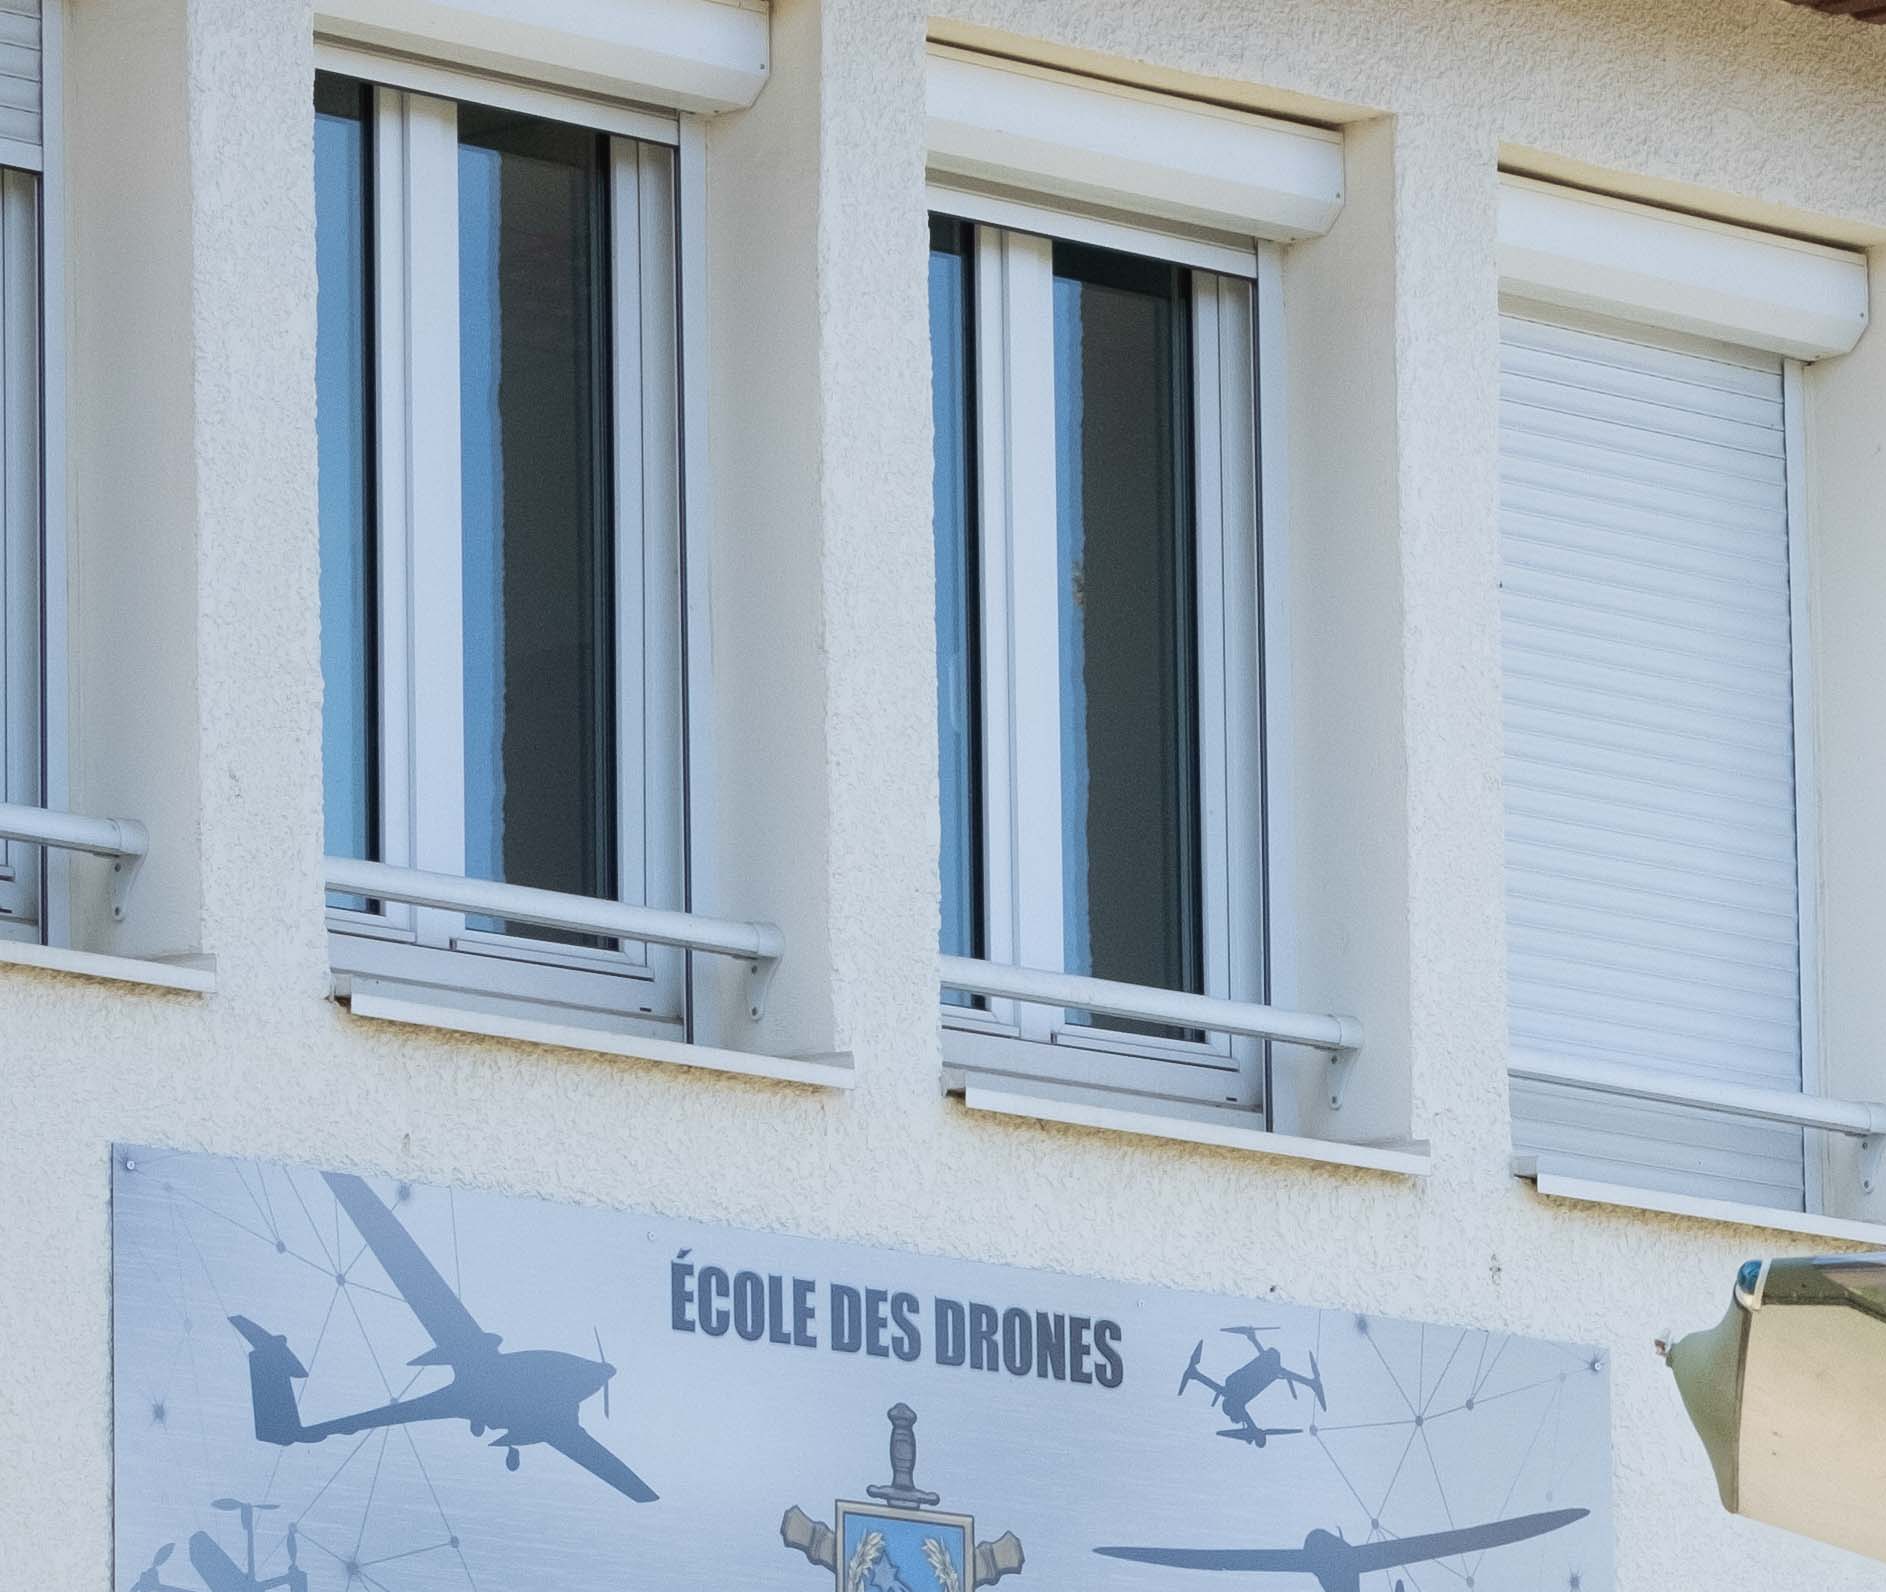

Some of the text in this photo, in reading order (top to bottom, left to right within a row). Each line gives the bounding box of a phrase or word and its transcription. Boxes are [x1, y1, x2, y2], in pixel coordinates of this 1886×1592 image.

[671, 1248, 1124, 1388] ÉCOLE DES DRONES
